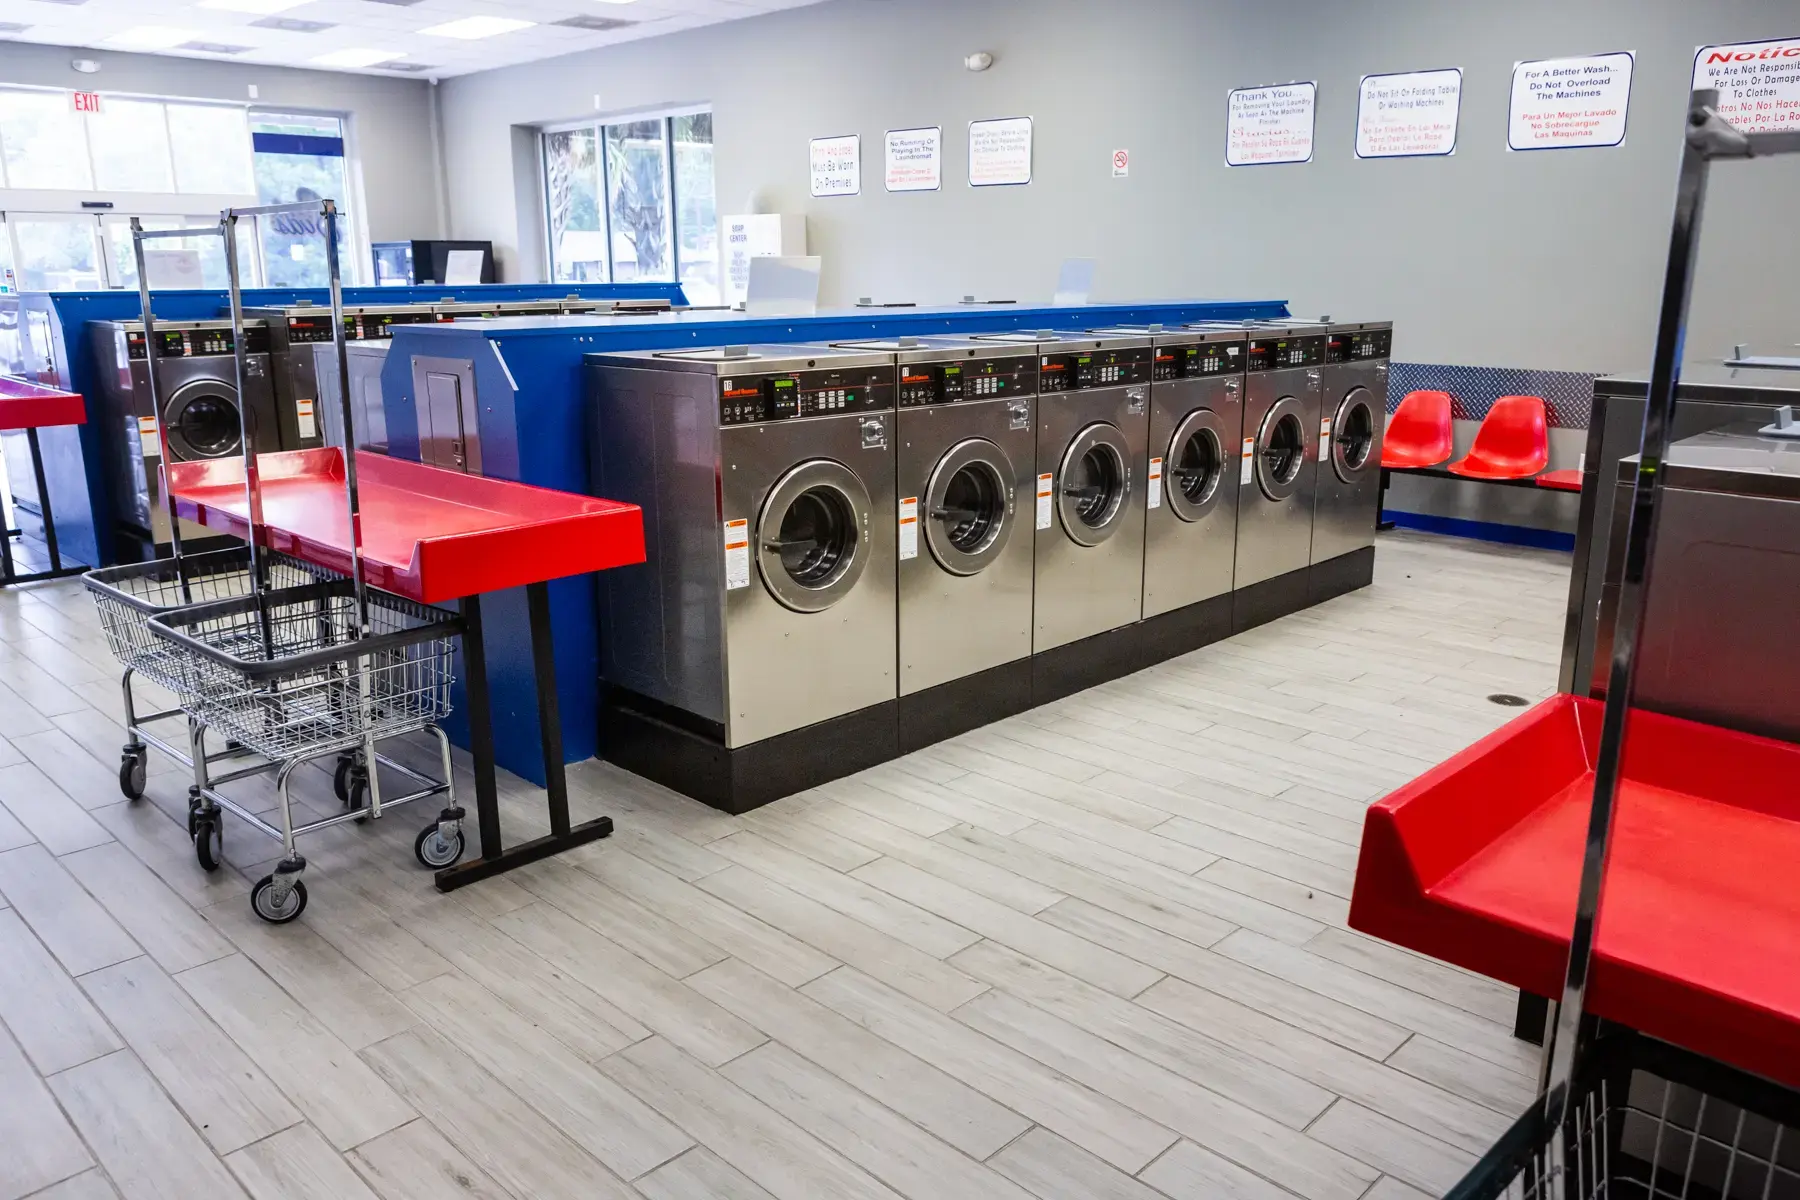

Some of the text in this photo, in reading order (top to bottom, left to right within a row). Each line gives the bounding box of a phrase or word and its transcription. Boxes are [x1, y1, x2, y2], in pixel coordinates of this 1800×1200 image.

[1553, 69, 1580, 77] Better
[1584, 65, 1618, 74] Wash...
[1708, 68, 1721, 76] We
[1724, 67, 1738, 75] Are
[1741, 65, 1756, 74] Not
[1567, 77, 1611, 87] Overload
[1714, 80, 1727, 88] For
[1731, 78, 1748, 87] Loss
[1751, 76, 1761, 85] Or
[1235, 92, 1267, 102] Thank
[1401, 89, 1410, 97] On
[1412, 88, 1435, 96] Folding
[1537, 90, 1601, 100] The Machines
[1733, 88, 1777, 98] To Clothes
[74, 92, 100, 111] EXIT
[1378, 99, 1444, 110] Or Washing Machines
[1740, 103, 1752, 111] No
[1756, 101, 1772, 110] Nos
[1776, 100, 1800, 108] Hace
[1584, 108, 1617, 117] Lavado
[1755, 114, 1771, 122] Por
[1774, 113, 1785, 121] La
[1545, 120, 1599, 129] Sobrecargue
[1552, 129, 1593, 138] Maquinas
[729, 234, 747, 243] CENTER
[724, 381, 732, 391] 16
